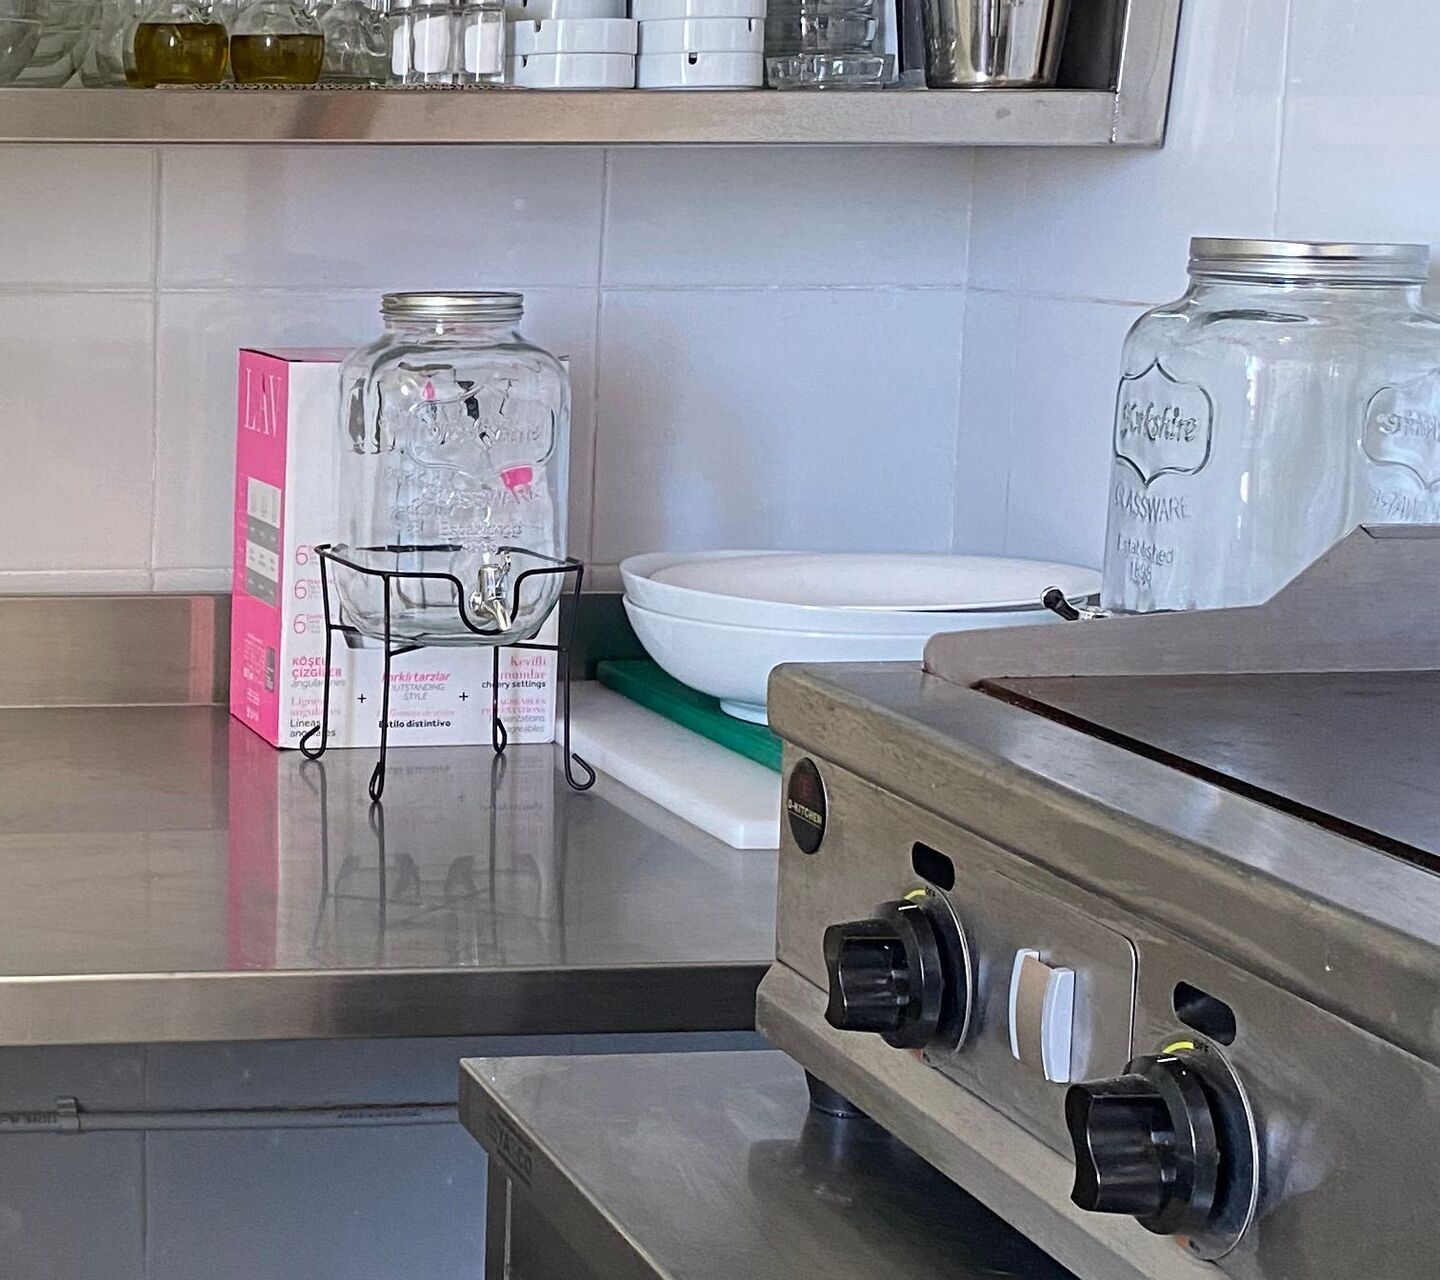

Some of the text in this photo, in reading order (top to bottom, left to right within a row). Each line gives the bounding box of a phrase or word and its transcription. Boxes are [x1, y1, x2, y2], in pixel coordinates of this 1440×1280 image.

[295, 544, 309, 566] 6
[294, 578, 307, 600] 6
[293, 613, 306, 635] 6
[512, 681, 546, 690] settings
[406, 719, 451, 729] distintivo
